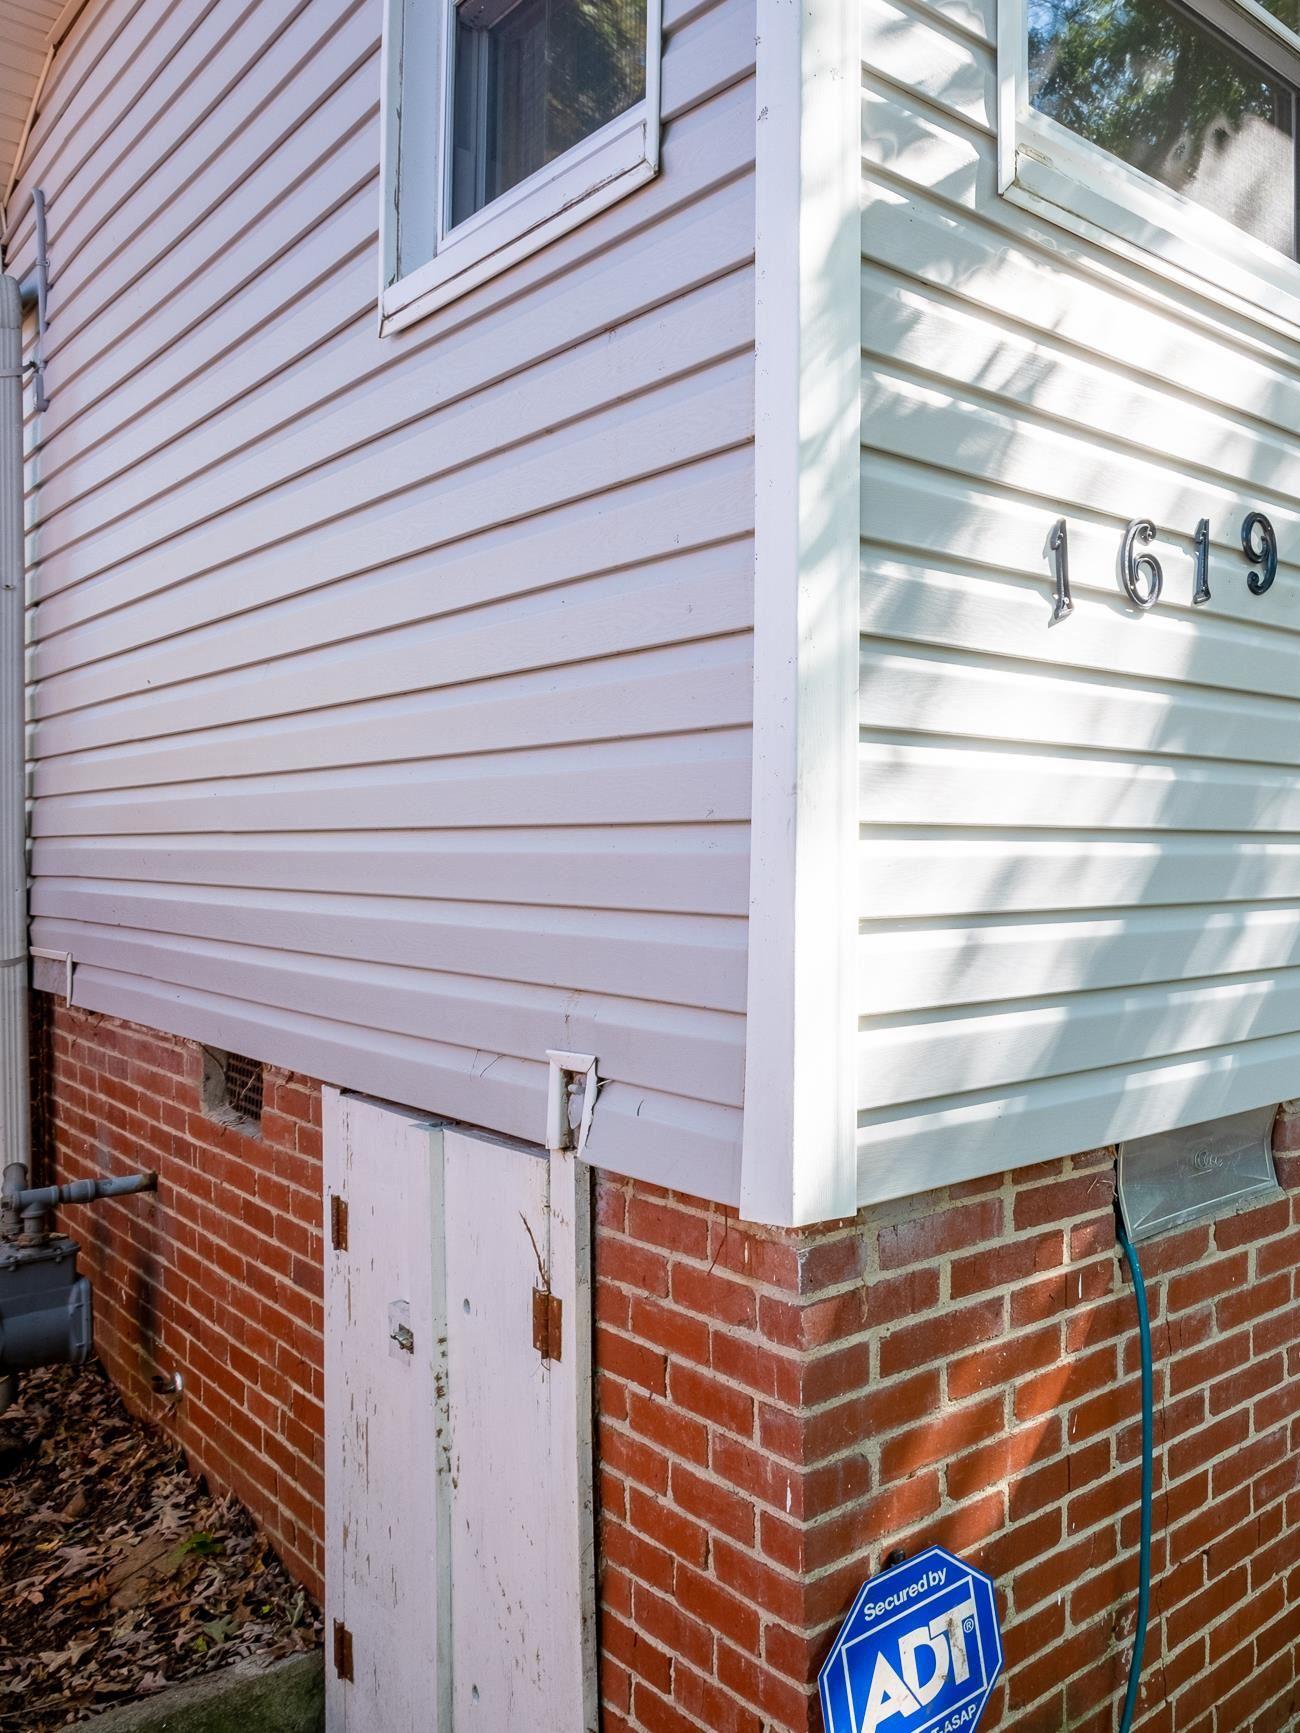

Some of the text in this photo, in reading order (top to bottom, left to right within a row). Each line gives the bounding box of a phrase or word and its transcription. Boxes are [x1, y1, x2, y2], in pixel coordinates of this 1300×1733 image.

[1053, 511, 1278, 620] 1619
[863, 1567, 947, 1622] Secured by
